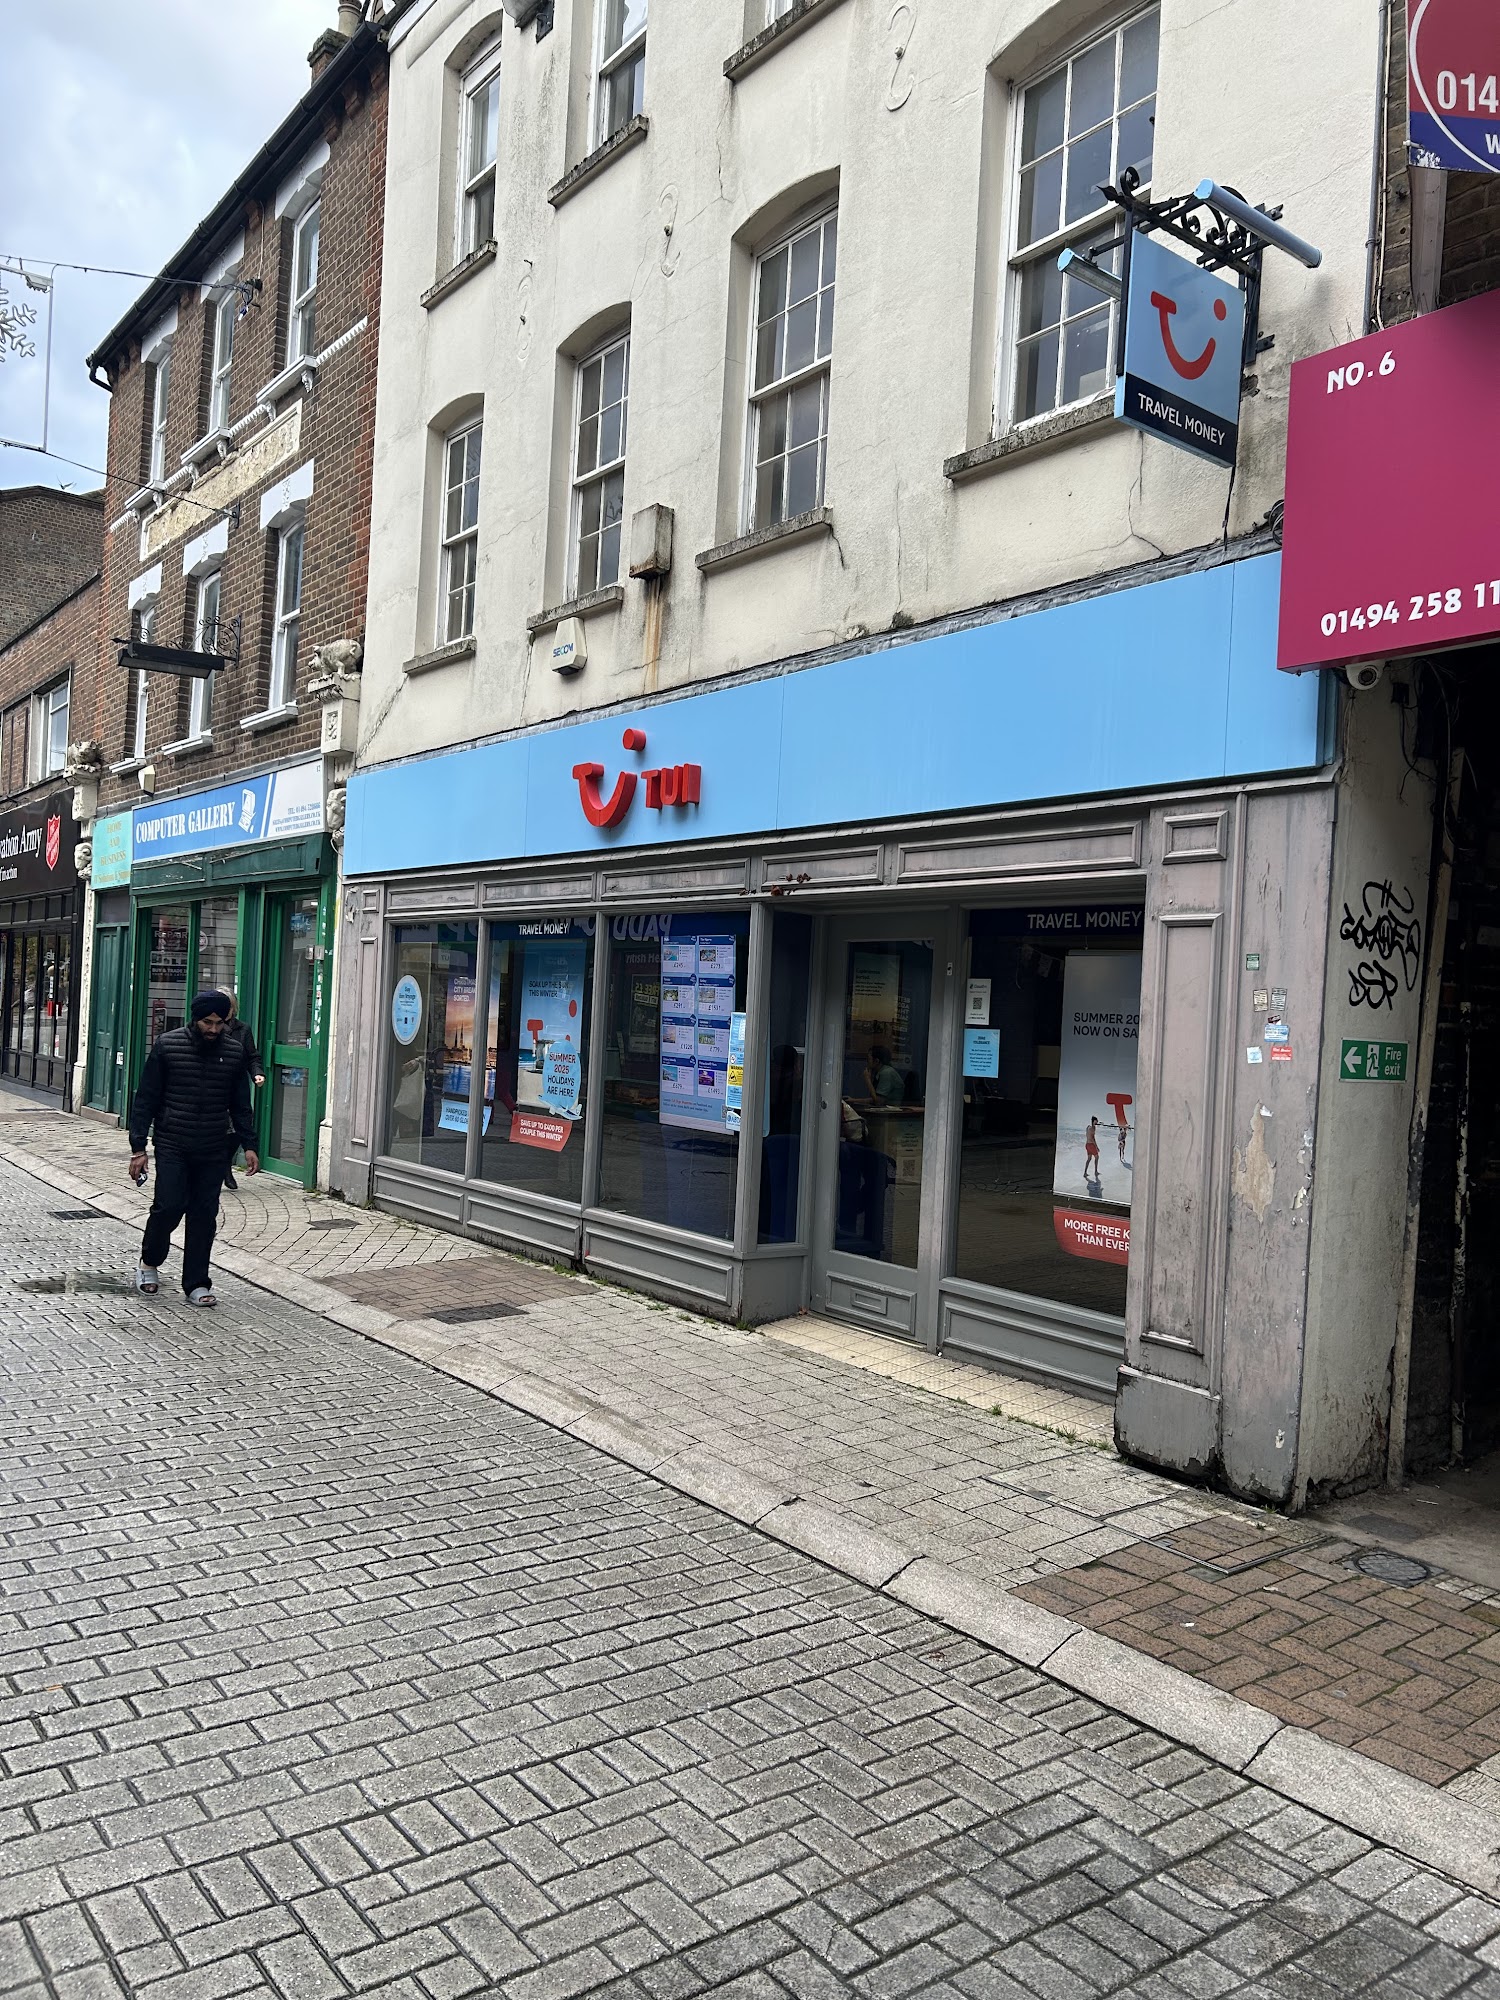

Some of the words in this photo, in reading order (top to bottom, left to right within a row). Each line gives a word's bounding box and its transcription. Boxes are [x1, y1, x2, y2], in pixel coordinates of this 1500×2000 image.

[1138, 392, 1182, 428] TRAVEL
[1184, 414, 1225, 446] MONEY
[1320, 600, 1400, 637] 01494
[1407, 588, 1462, 622] 258
[553, 642, 574, 657] SECOM
[641, 763, 701, 811] TUI
[136, 813, 186, 844] COMPUTER
[188, 801, 235, 834] GALLERY
[0, 829, 19, 859] ation
[19, 825, 43, 858] Army
[100, 850, 127, 866] BUSINESS
[1027, 913, 1081, 929] TRAVEL
[1085, 911, 1142, 928] MONEY
[518, 924, 542, 935] TRAVEL
[543, 923, 569, 934] MONEY
[529, 980, 541, 988] SOAK
[529, 989, 540, 997] THIS
[1073, 1012, 1123, 1024] SUMMER
[1073, 1025, 1101, 1036] NOW
[1103, 1026, 1120, 1037] ON
[549, 1052, 576, 1064] SUMMER
[1384, 1046, 1402, 1061] Fire
[554, 1064, 570, 1075] 2025
[1384, 1061, 1401, 1076] exit
[547, 1075, 575, 1087] HOLIDAYS
[546, 1086, 558, 1095] ARE
[559, 1087, 575, 1098] HERE
[445, 1106, 468, 1116] HANDPICKED
[520, 1119, 531, 1127] SAVE
[531, 1120, 538, 1128] UP
[538, 1121, 543, 1130] TO
[555, 1124, 564, 1133] PER
[520, 1128, 536, 1138] COUPLE
[536, 1130, 545, 1139] THIS
[1064, 1218, 1093, 1233] MORE
[1095, 1224, 1121, 1238] FREE
[1076, 1232, 1103, 1247] THAN
